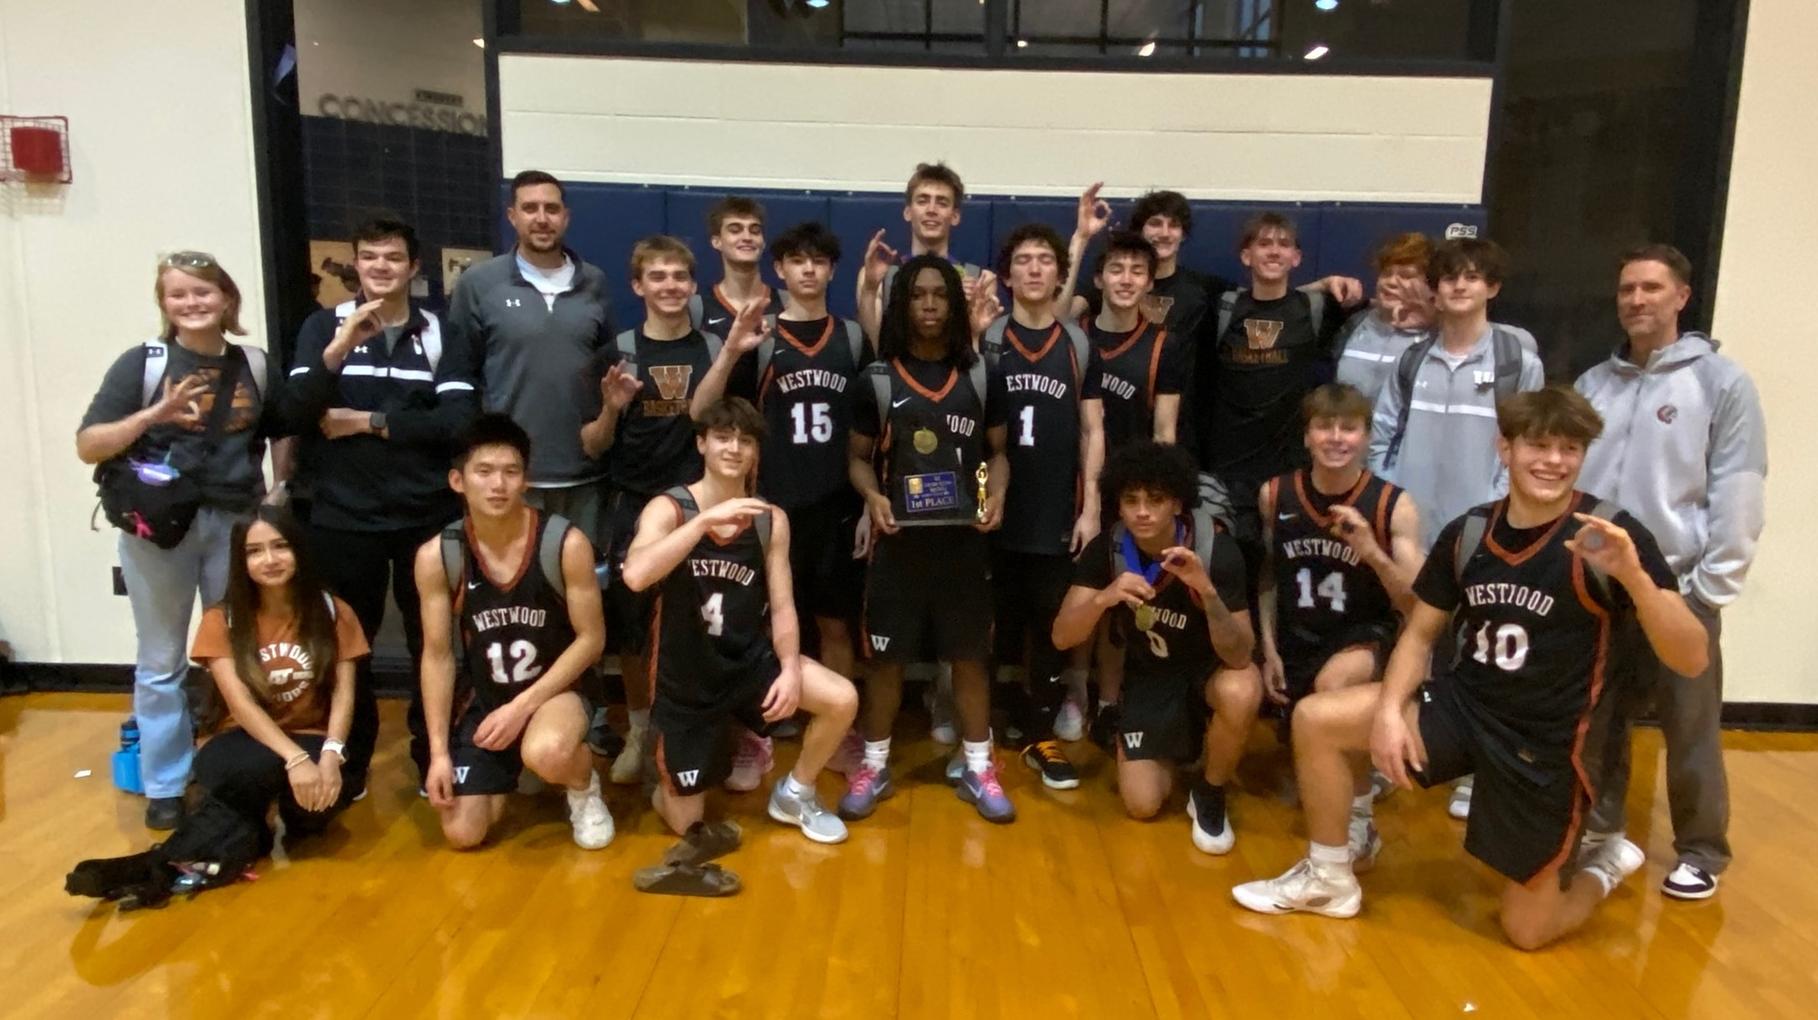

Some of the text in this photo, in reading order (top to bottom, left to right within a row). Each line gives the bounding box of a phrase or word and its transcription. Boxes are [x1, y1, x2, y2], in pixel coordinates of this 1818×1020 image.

[1449, 226, 1477, 237] PSS
[1243, 318, 1284, 349] W
[648, 365, 693, 400] W
[776, 369, 847, 394] WESTWOOD
[1005, 373, 1067, 400] ESTWOOD
[791, 402, 833, 444] 15
[1019, 405, 1035, 447] 1
[925, 496, 956, 508] PLACE
[1283, 538, 1361, 567] WESTWOOD
[688, 559, 755, 586] ESTWOOD
[1296, 568, 1347, 612] 14
[472, 606, 546, 632] WESTWOOD
[701, 592, 724, 637] 4
[870, 634, 890, 651] W
[1473, 620, 1529, 671] 10
[486, 639, 543, 684] 12
[1124, 731, 1144, 748] W
[677, 769, 700, 787] W
